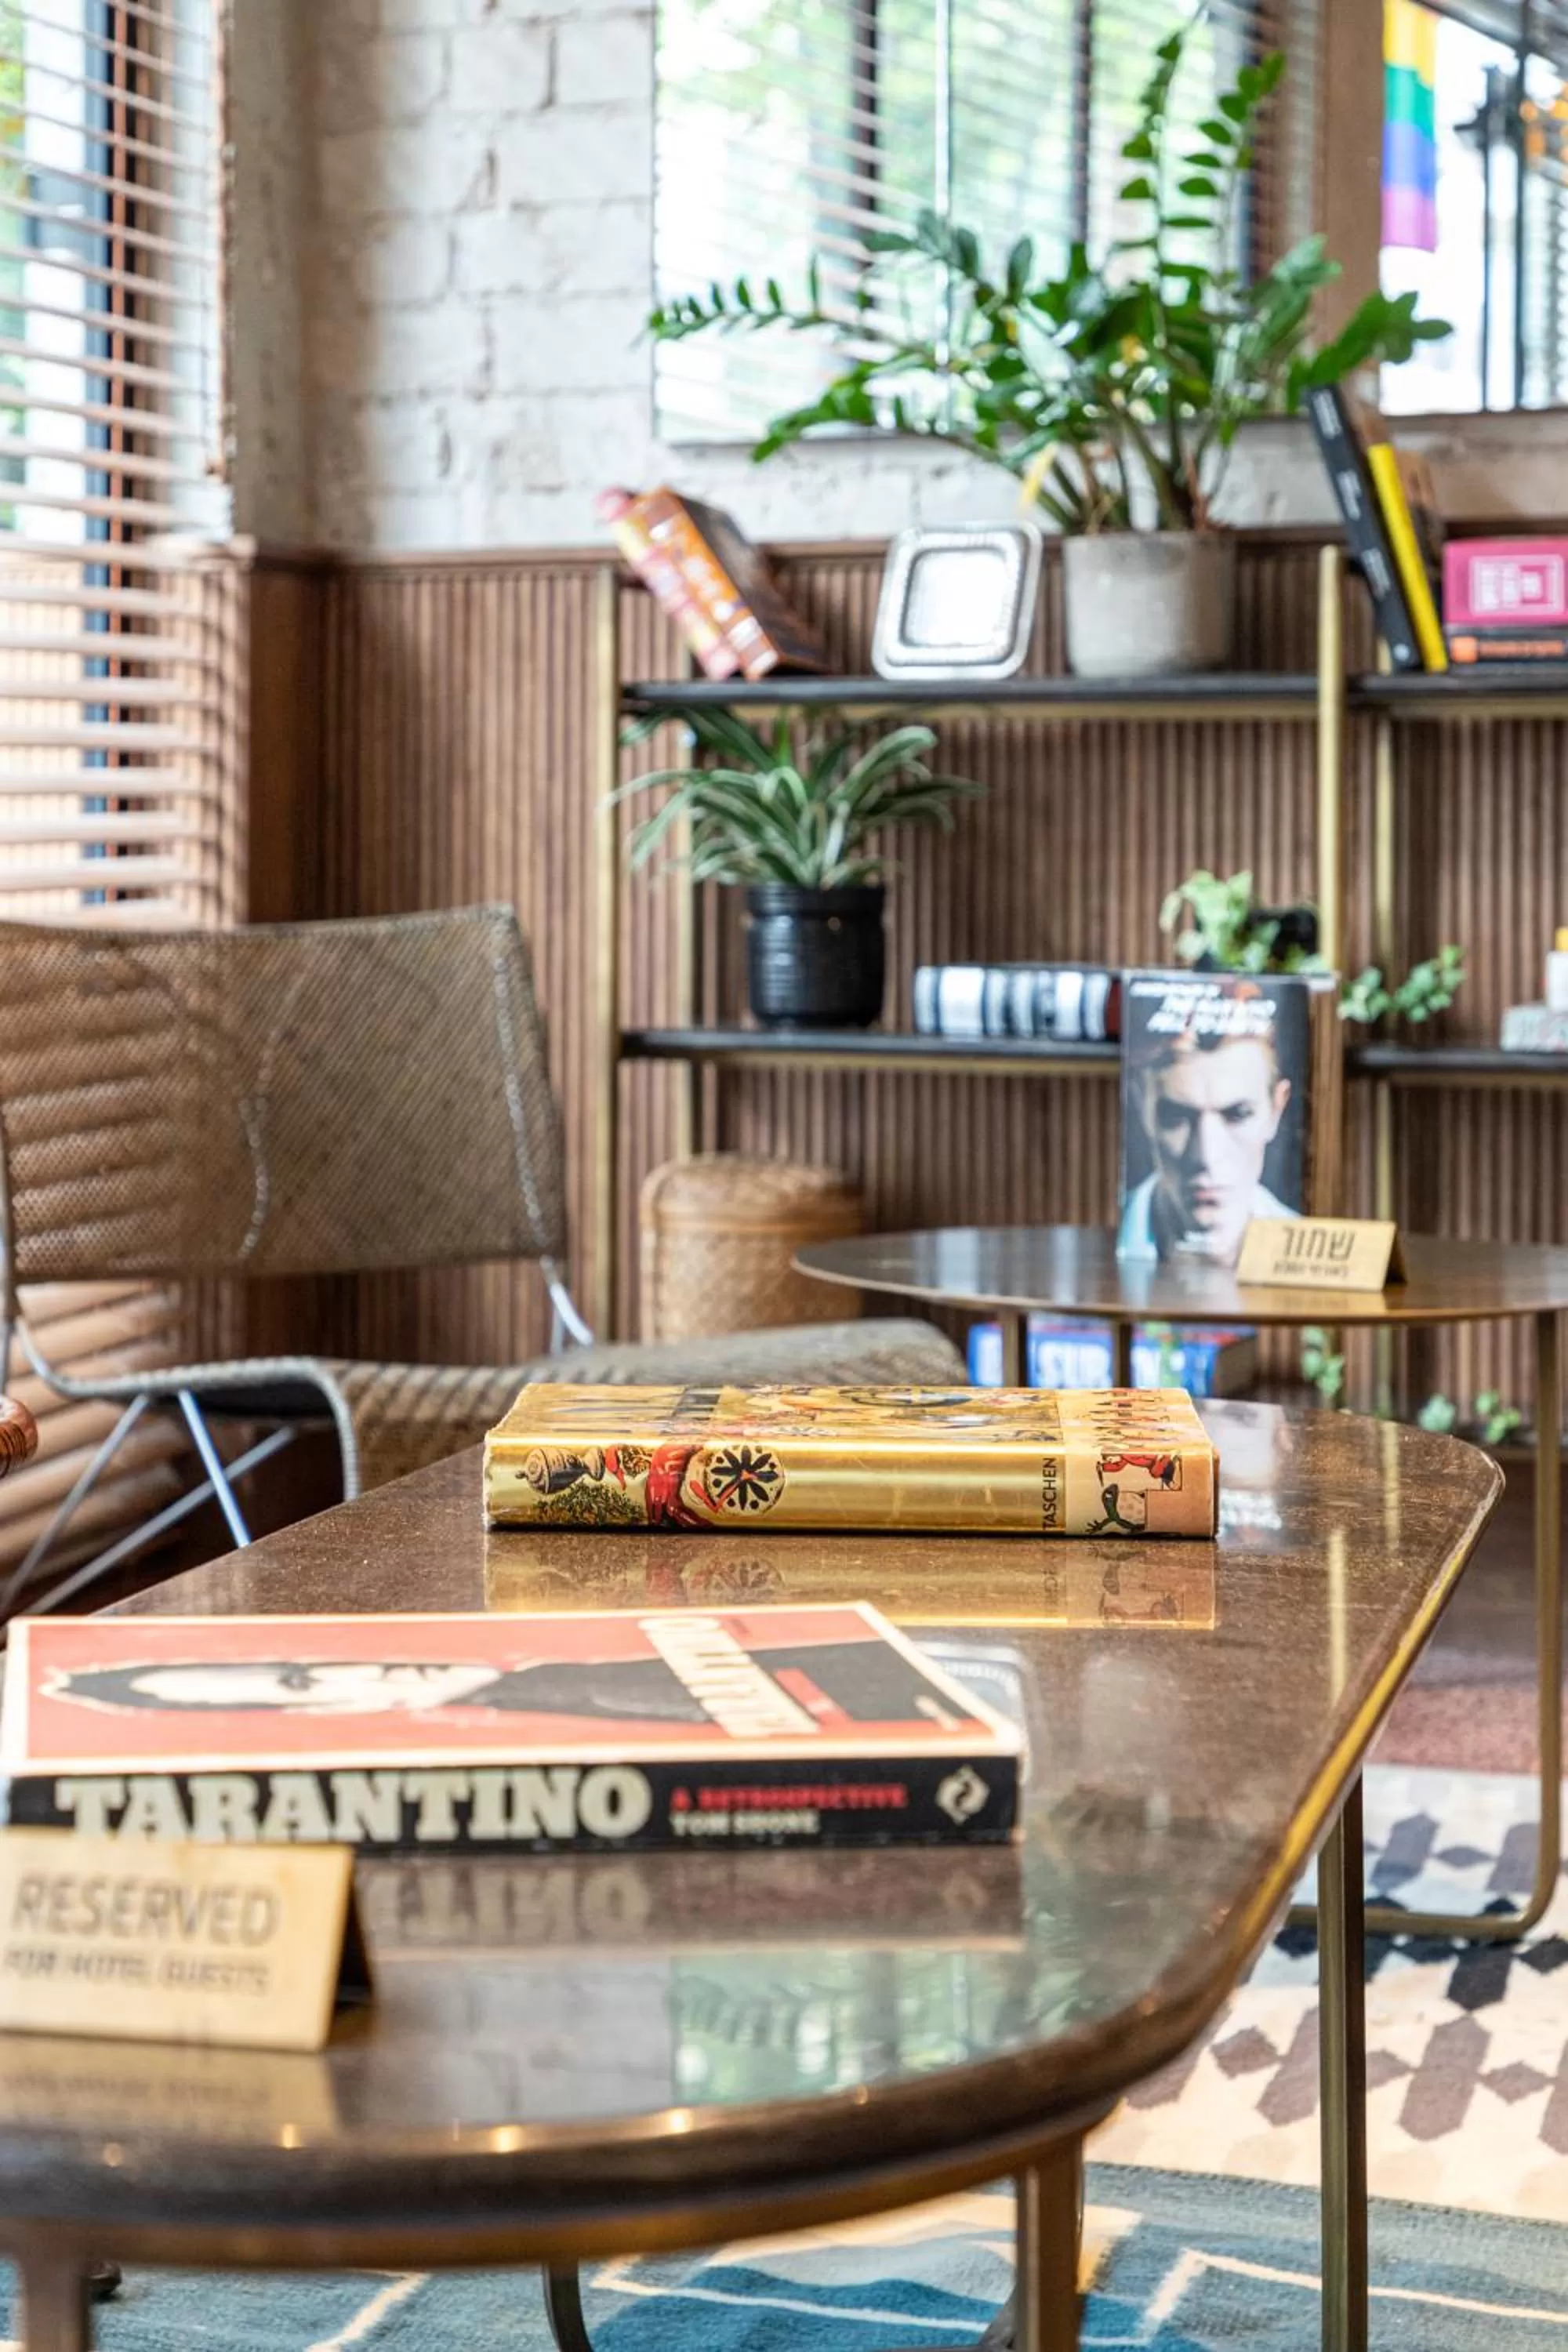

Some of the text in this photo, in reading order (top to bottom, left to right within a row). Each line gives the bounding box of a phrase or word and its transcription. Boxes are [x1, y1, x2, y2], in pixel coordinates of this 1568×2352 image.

[1043, 1457, 1057, 1530] TASCHEN
[55, 1766, 652, 1840] TARANTINO
[9, 1872, 280, 1947] RESERVED
